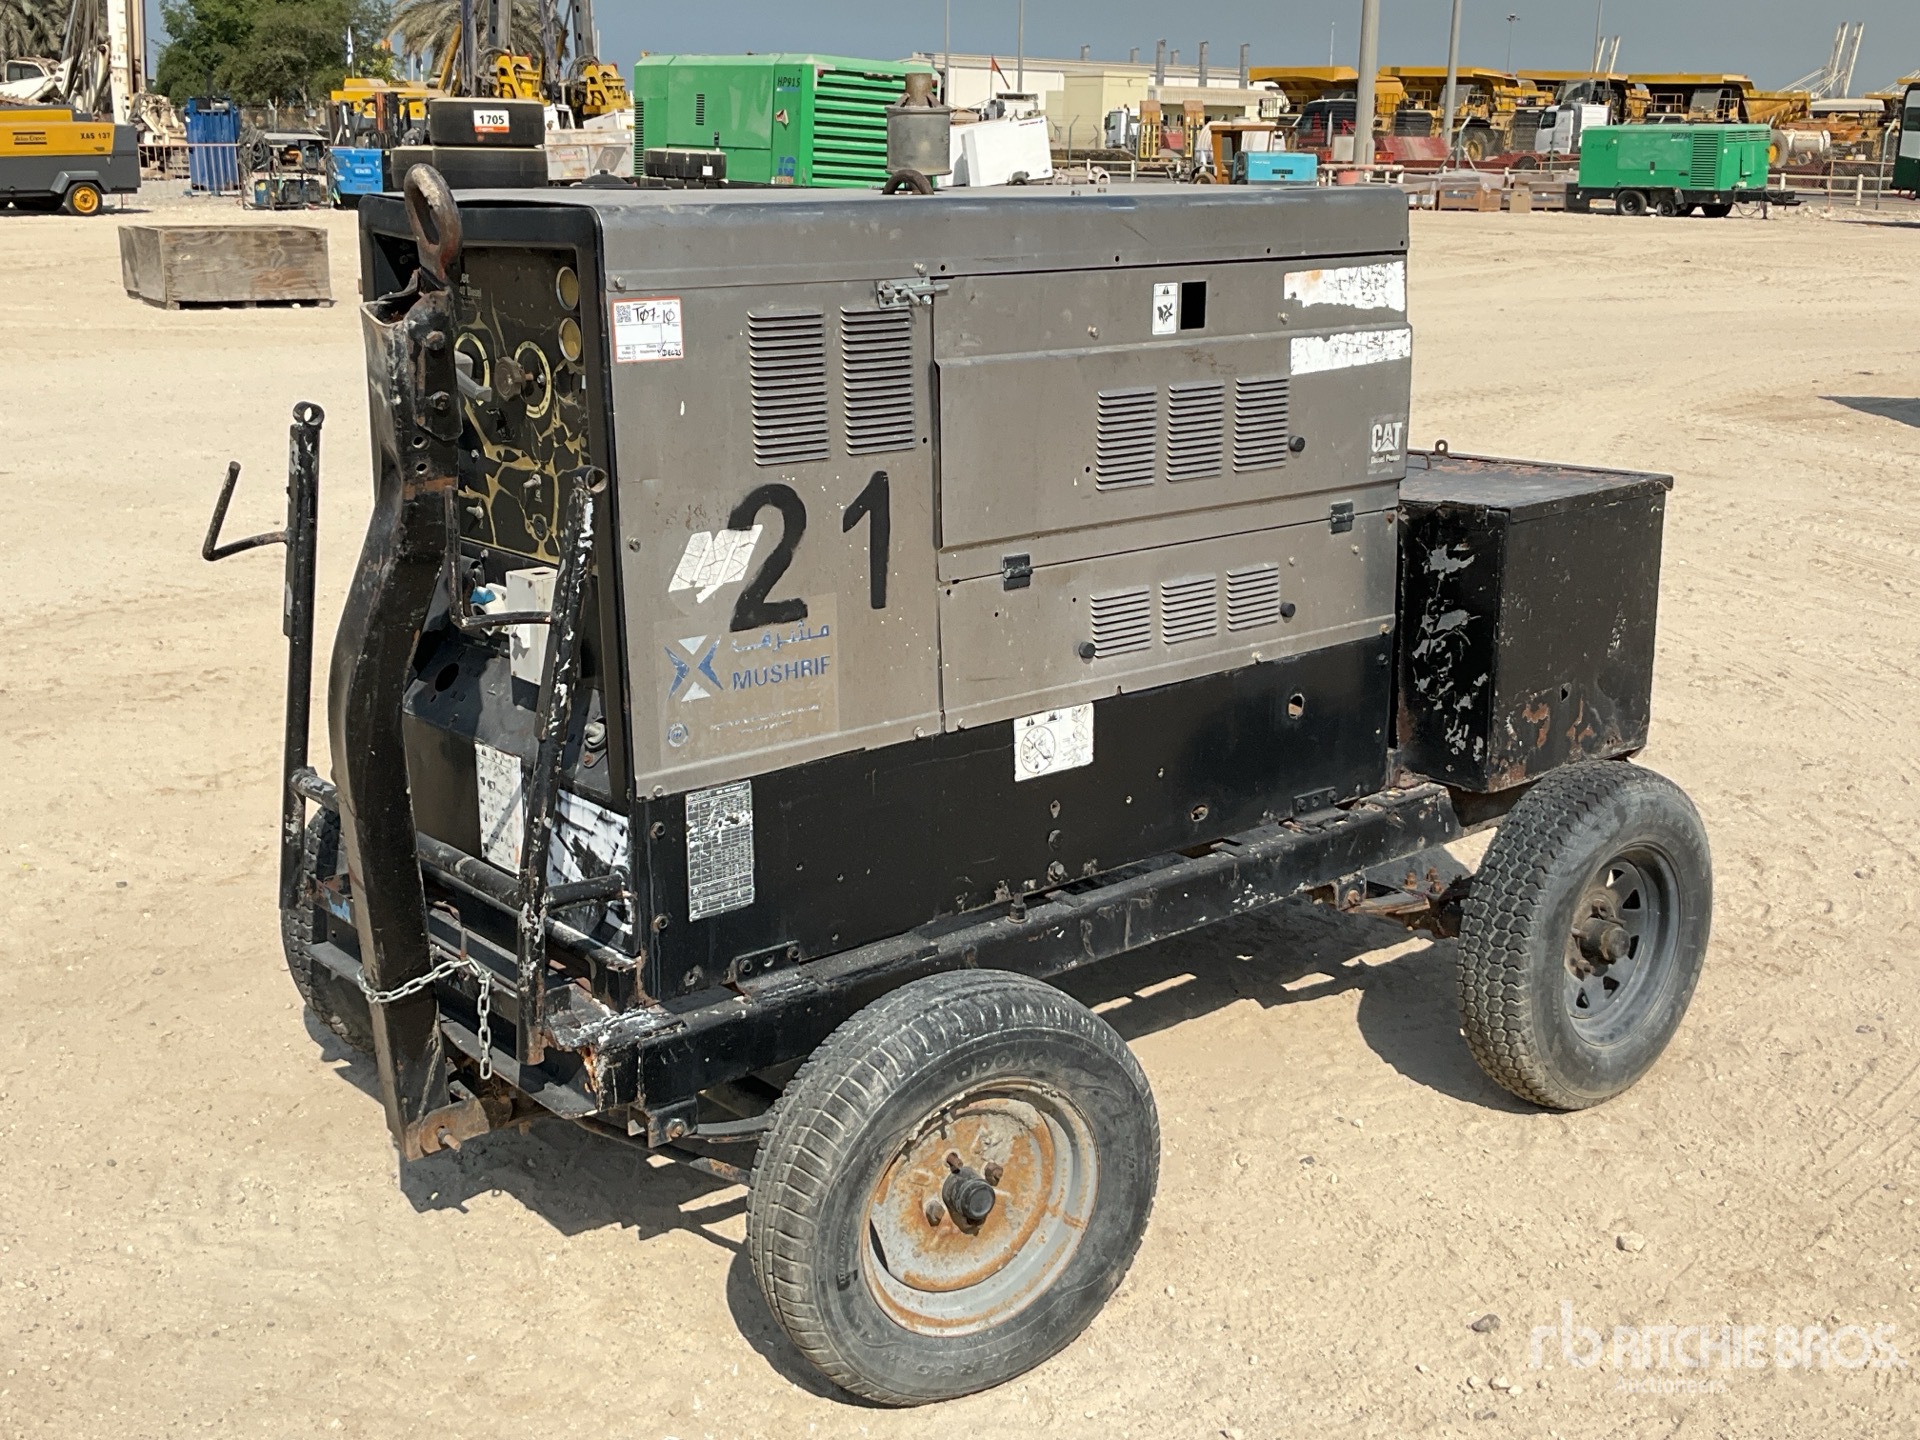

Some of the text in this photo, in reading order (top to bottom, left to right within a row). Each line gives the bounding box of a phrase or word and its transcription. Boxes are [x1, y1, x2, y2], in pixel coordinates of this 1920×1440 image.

[777, 76, 801, 88] HP915
[479, 114, 505, 125] 1705
[80, 132, 95, 140] XAS
[1371, 422, 1403, 452] CAT
[727, 470, 891, 633] 21
[732, 655, 831, 691] MUSHRIF
